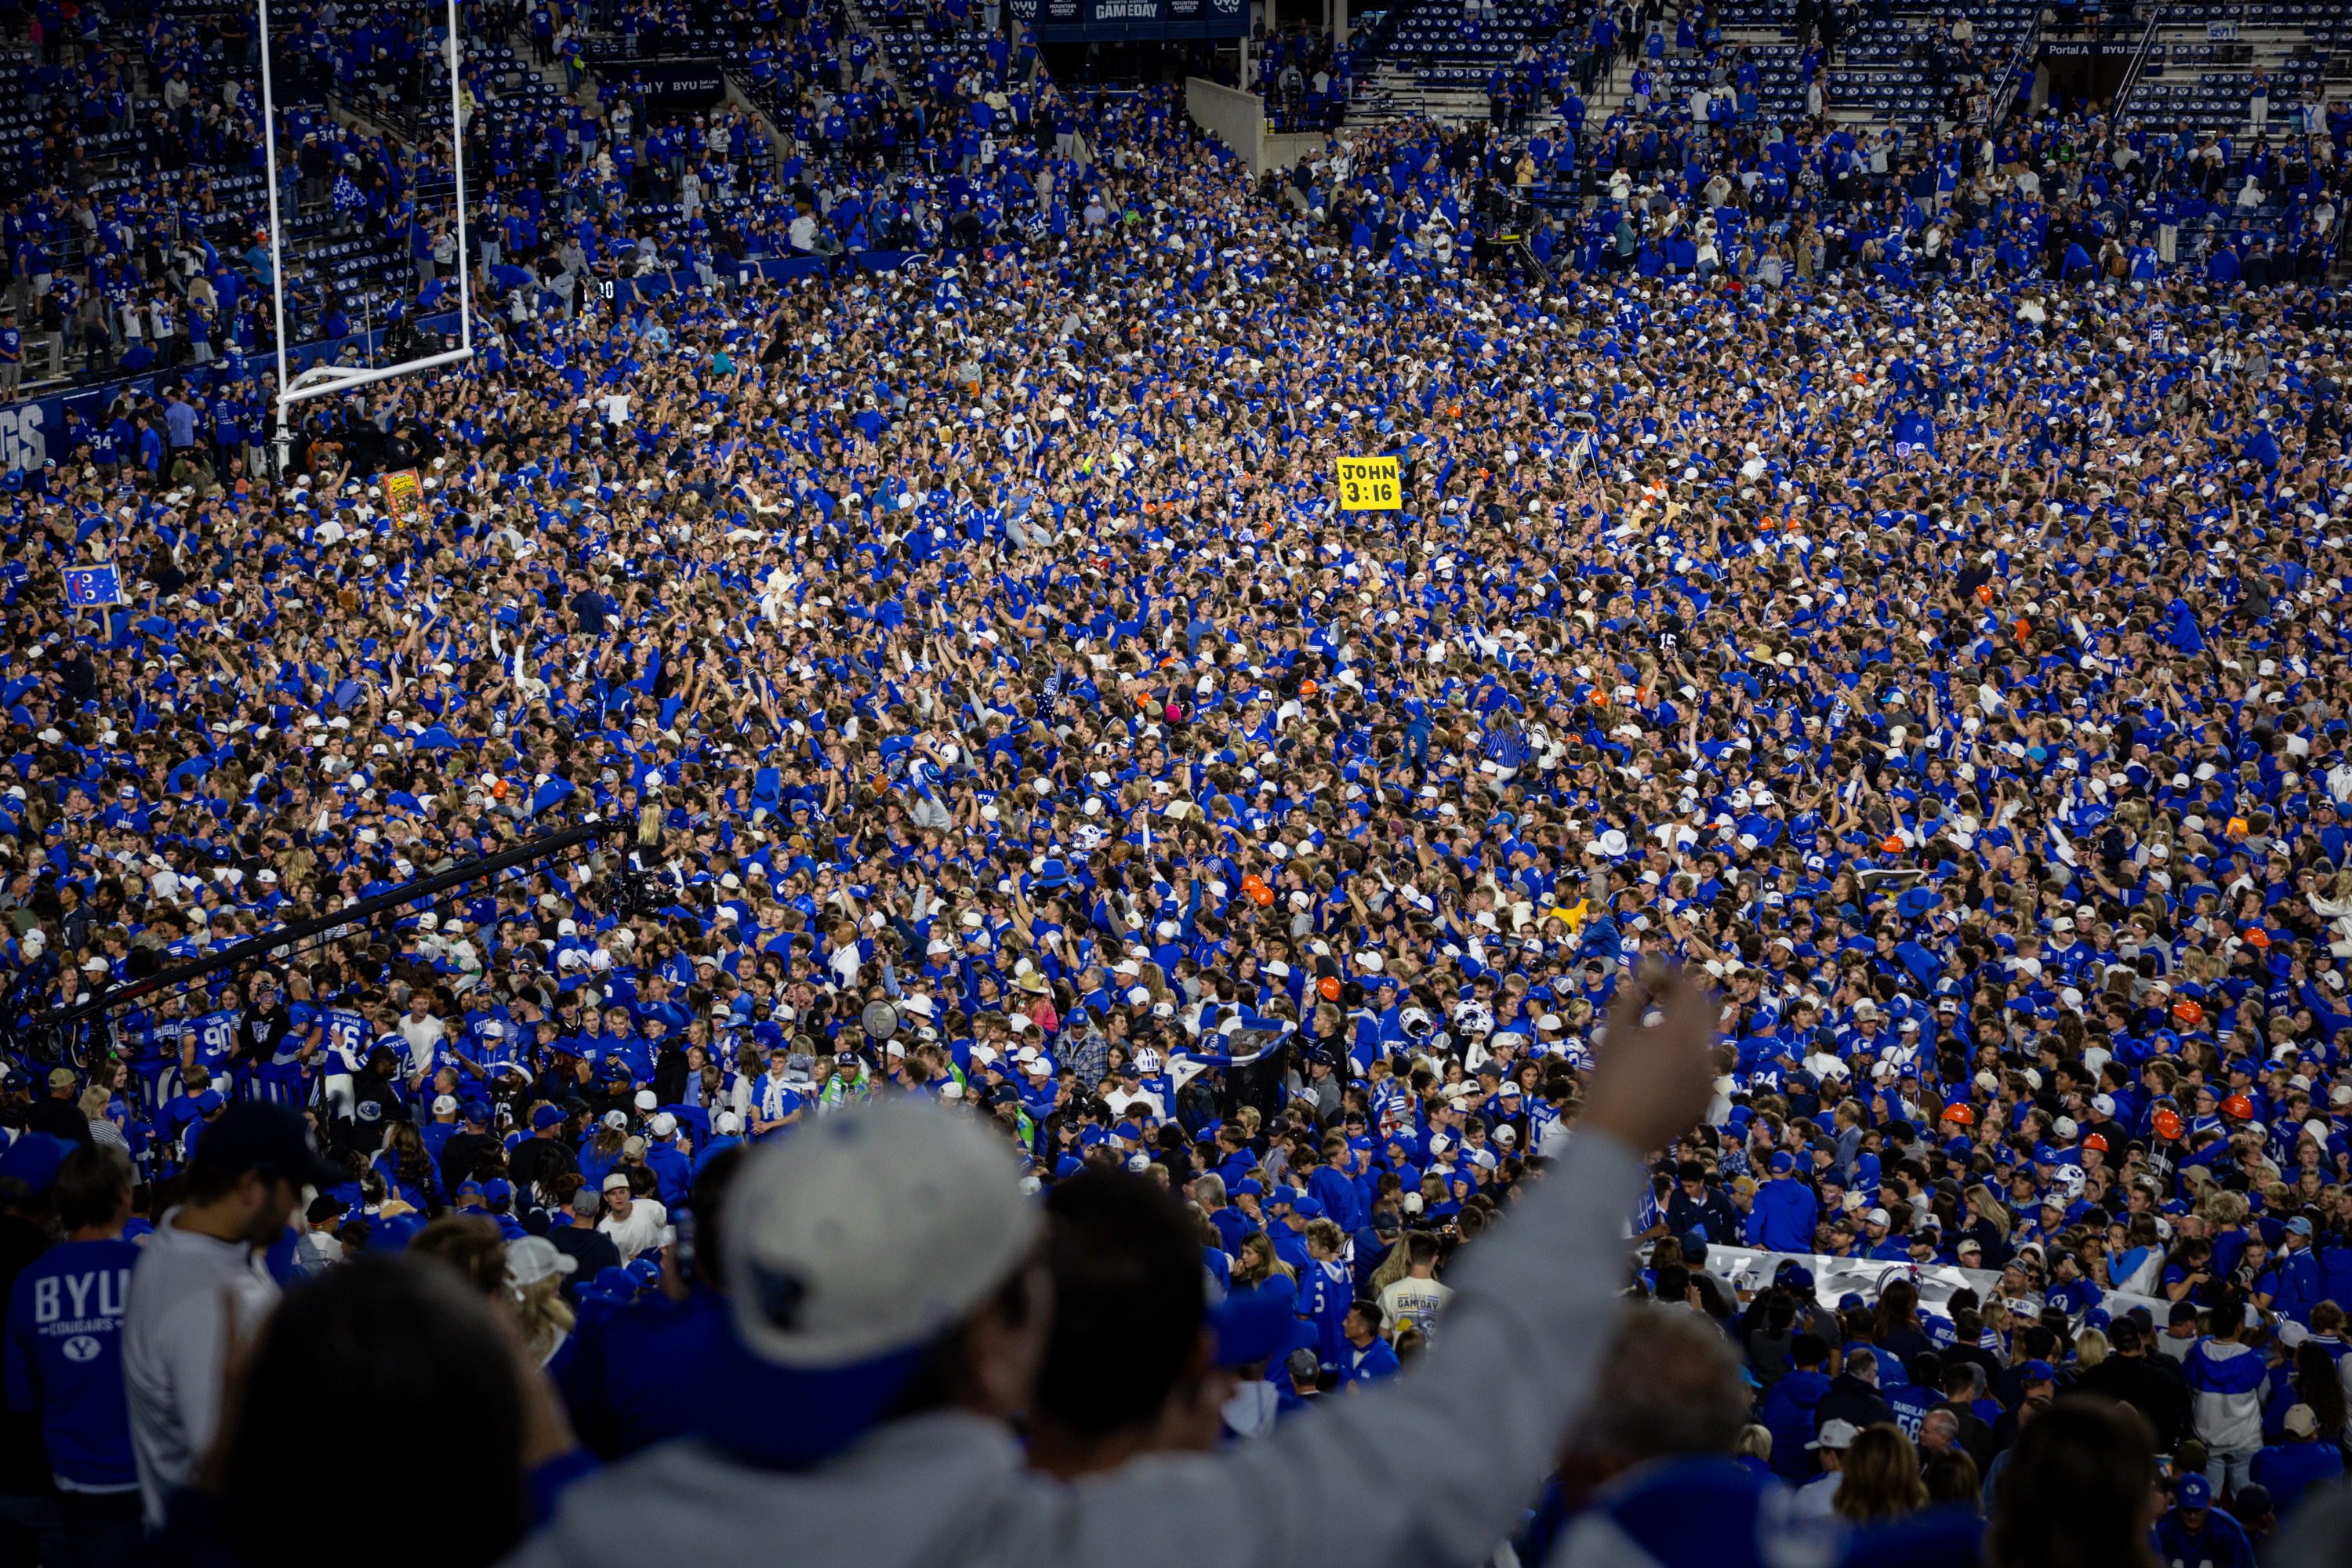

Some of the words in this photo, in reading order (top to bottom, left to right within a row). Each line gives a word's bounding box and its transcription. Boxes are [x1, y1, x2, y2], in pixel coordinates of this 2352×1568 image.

[1096, 3, 1157, 20] GAMEDAY
[2049, 45, 2078, 55] Portal
[2081, 45, 2089, 54] A
[2102, 45, 2124, 54] BYU
[655, 82, 664, 93] Y
[673, 82, 697, 91] BYU
[111, 289, 126, 302] 34
[2152, 329, 2165, 340] 26
[93, 436, 111, 450] 34
[1342, 463, 1397, 481] JOHN
[1346, 484, 1393, 503] 3:16
[1659, 634, 1676, 651] 15
[2269, 991, 2288, 1000] BYU
[207, 1016, 223, 1026] CLEGG
[333, 1014, 361, 1027] GLASKER
[204, 1023, 231, 1056] 90
[328, 1022, 361, 1055] 16
[1754, 1071, 1777, 1091] 24
[1397, 1300, 1437, 1311] GAMEDAY
[1896, 1413, 1919, 1445] 58
